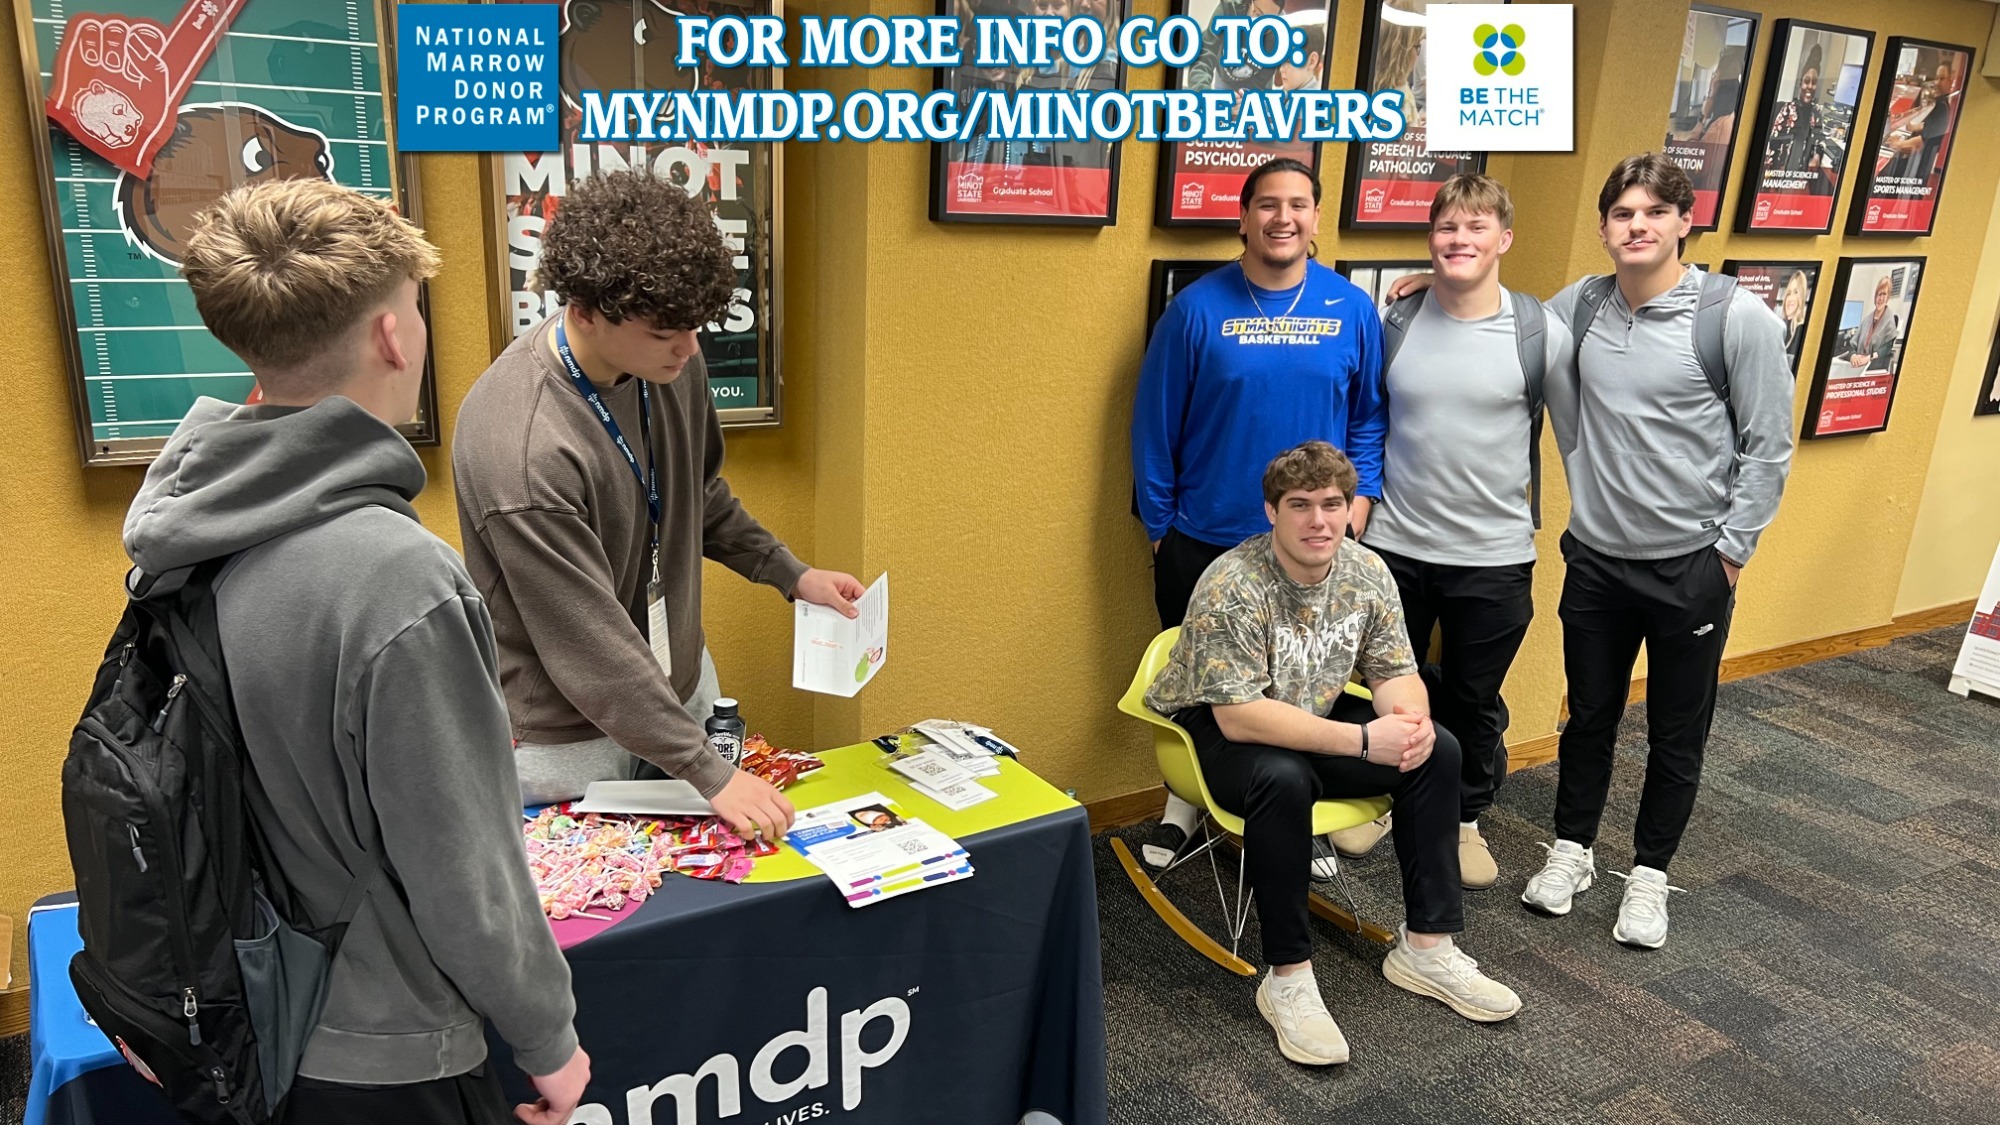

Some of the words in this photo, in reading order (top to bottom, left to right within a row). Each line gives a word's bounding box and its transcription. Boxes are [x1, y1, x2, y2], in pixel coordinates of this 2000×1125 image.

[1371, 143, 1415, 157] SPEECH
[1676, 147, 1699, 156] SCIENCE
[1185, 151, 1276, 167] PSYCHOLOGY
[1369, 160, 1436, 174] PATHOLOGY
[1764, 169, 1785, 178] MASTER
[1793, 171, 1812, 179] SCIENCE
[957, 181, 983, 190] MINOT
[1762, 179, 1808, 190] MANAGEMENT
[1900, 177, 1917, 185] SCIENCE
[957, 190, 982, 198] STATE
[992, 186, 1027, 196] Graduate
[1028, 187, 1053, 196] School
[1873, 184, 1896, 194] SPORTS
[1895, 185, 1933, 195] MANAGEMENT
[1181, 197, 1203, 205] STATE
[1210, 193, 1241, 202] Graduate
[1389, 199, 1415, 207] Graduate
[127, 252, 142, 260] TM
[1238, 334, 1320, 345] BASKETBALL
[566, 355, 581, 379] nmdp
[711, 386, 744, 398] YOU.
[1825, 389, 1866, 400] PROFESSIONAL
[1865, 386, 1888, 396] STUDIES
[594, 401, 611, 423] nmdp
[763, 1102, 831, 1125] IVES.
